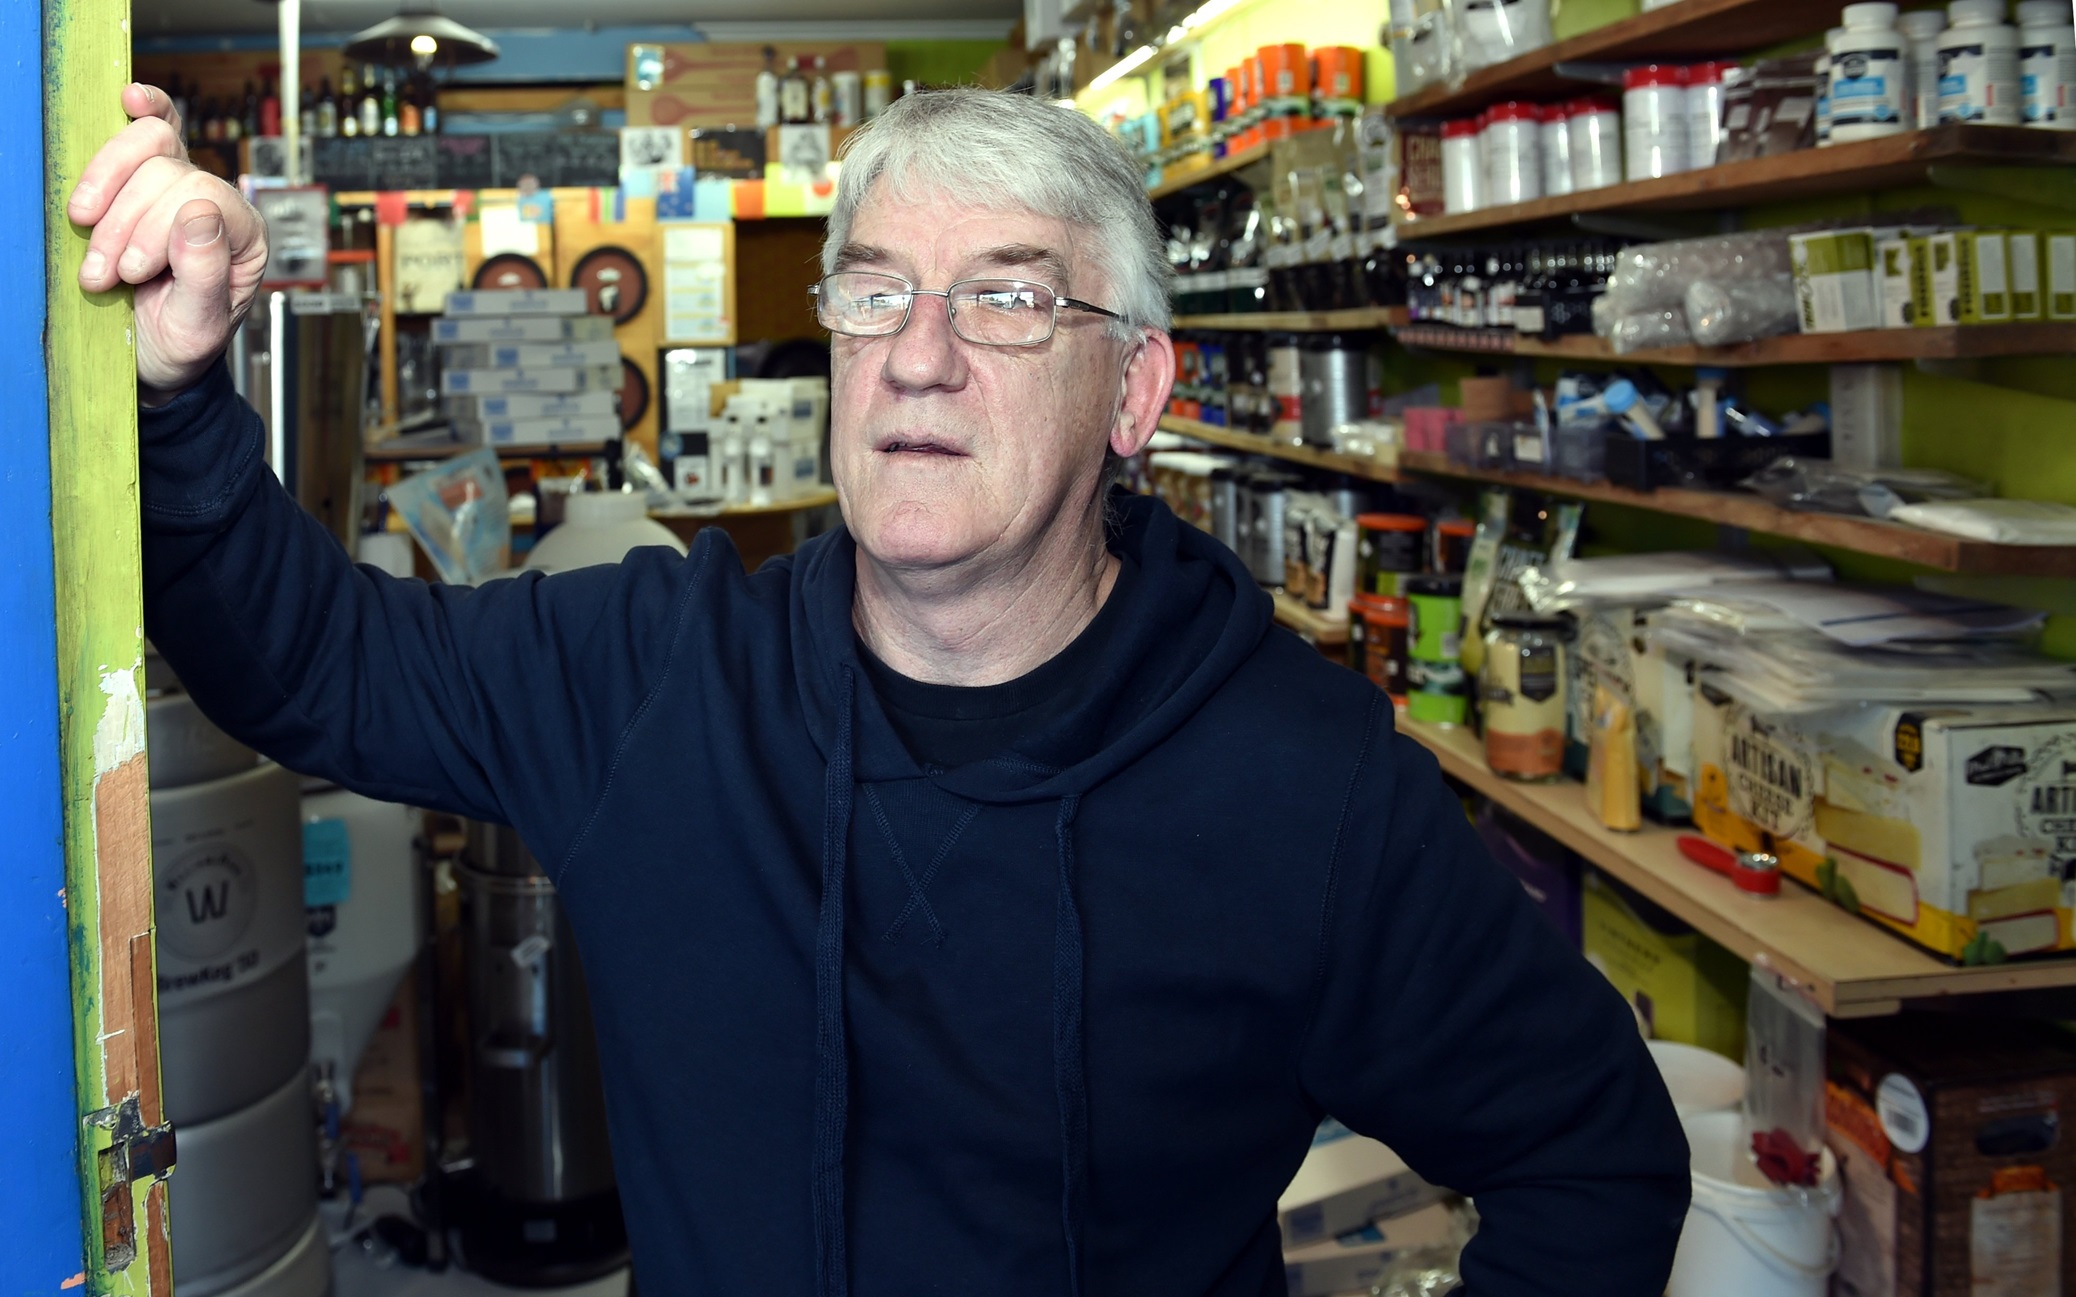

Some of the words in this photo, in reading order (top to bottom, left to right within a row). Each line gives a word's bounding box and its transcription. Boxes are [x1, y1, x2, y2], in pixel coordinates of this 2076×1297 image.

[1730, 734, 1802, 800] ARTISAN
[1739, 770, 1794, 817] CHEESE
[1751, 799, 1778, 829] KIT
[186, 881, 230, 924] W
